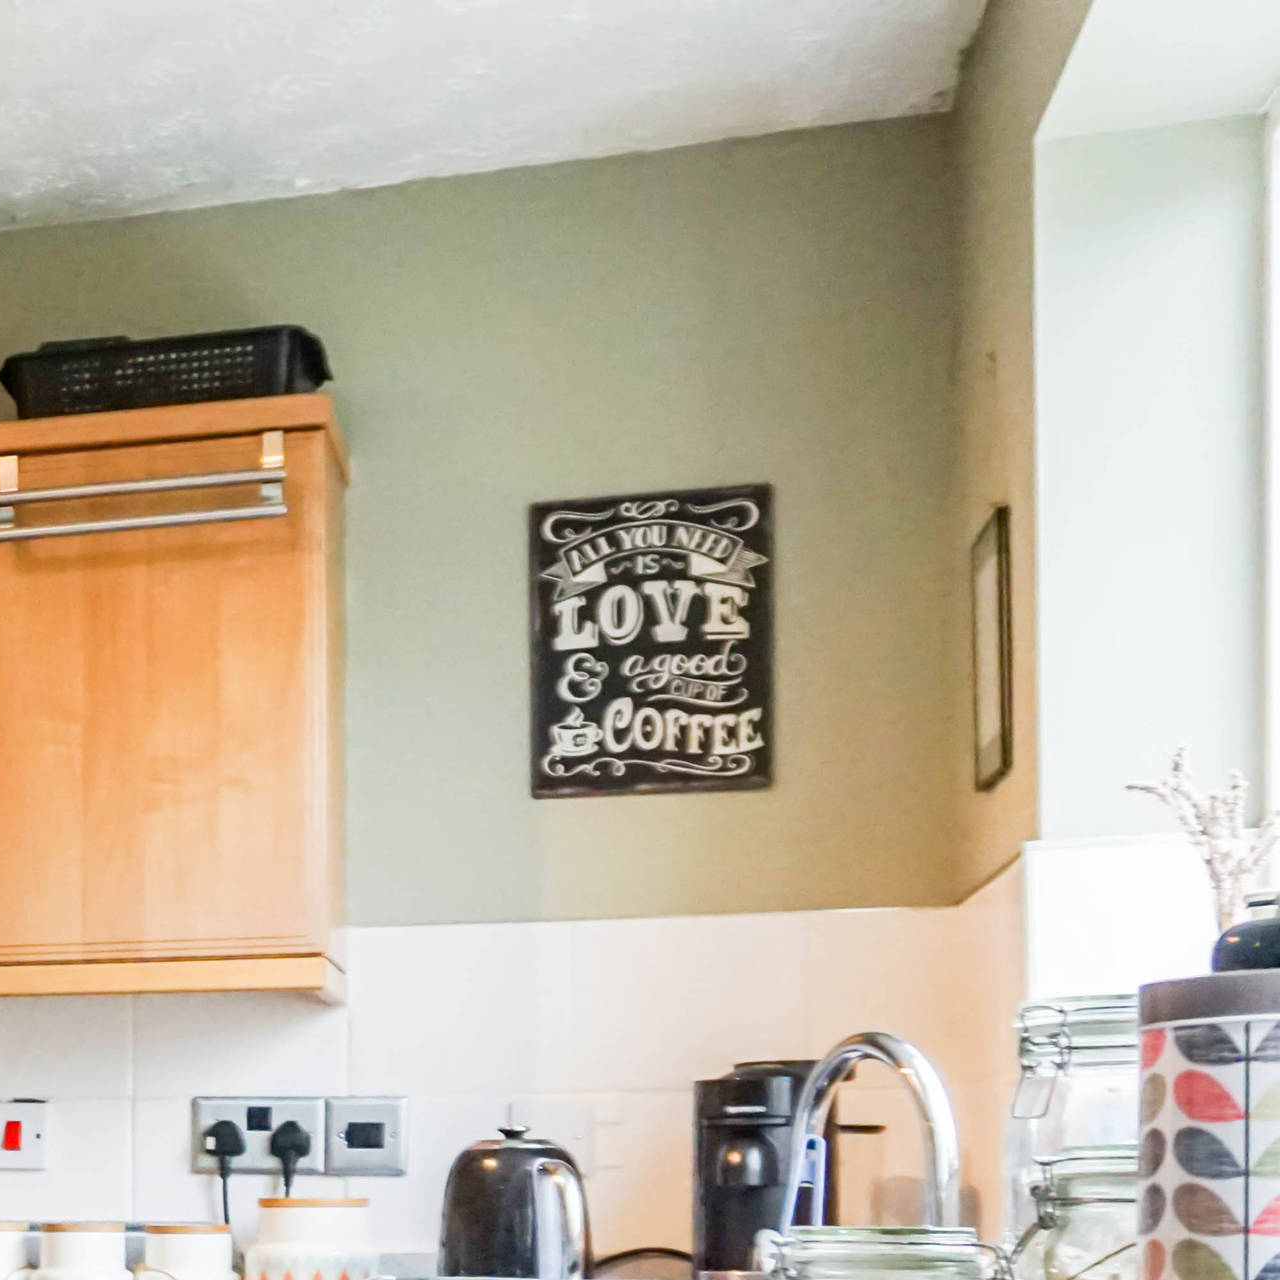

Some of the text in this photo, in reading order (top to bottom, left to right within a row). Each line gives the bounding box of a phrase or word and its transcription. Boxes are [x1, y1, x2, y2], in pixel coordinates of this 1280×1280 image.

[572, 525, 734, 571] ALL YOU NEED
[636, 553, 660, 575] IS
[552, 579, 751, 651] LOVE
[558, 640, 749, 703] & a good
[669, 678, 729, 702] CUP OF
[602, 696, 766, 755] COFFEE
